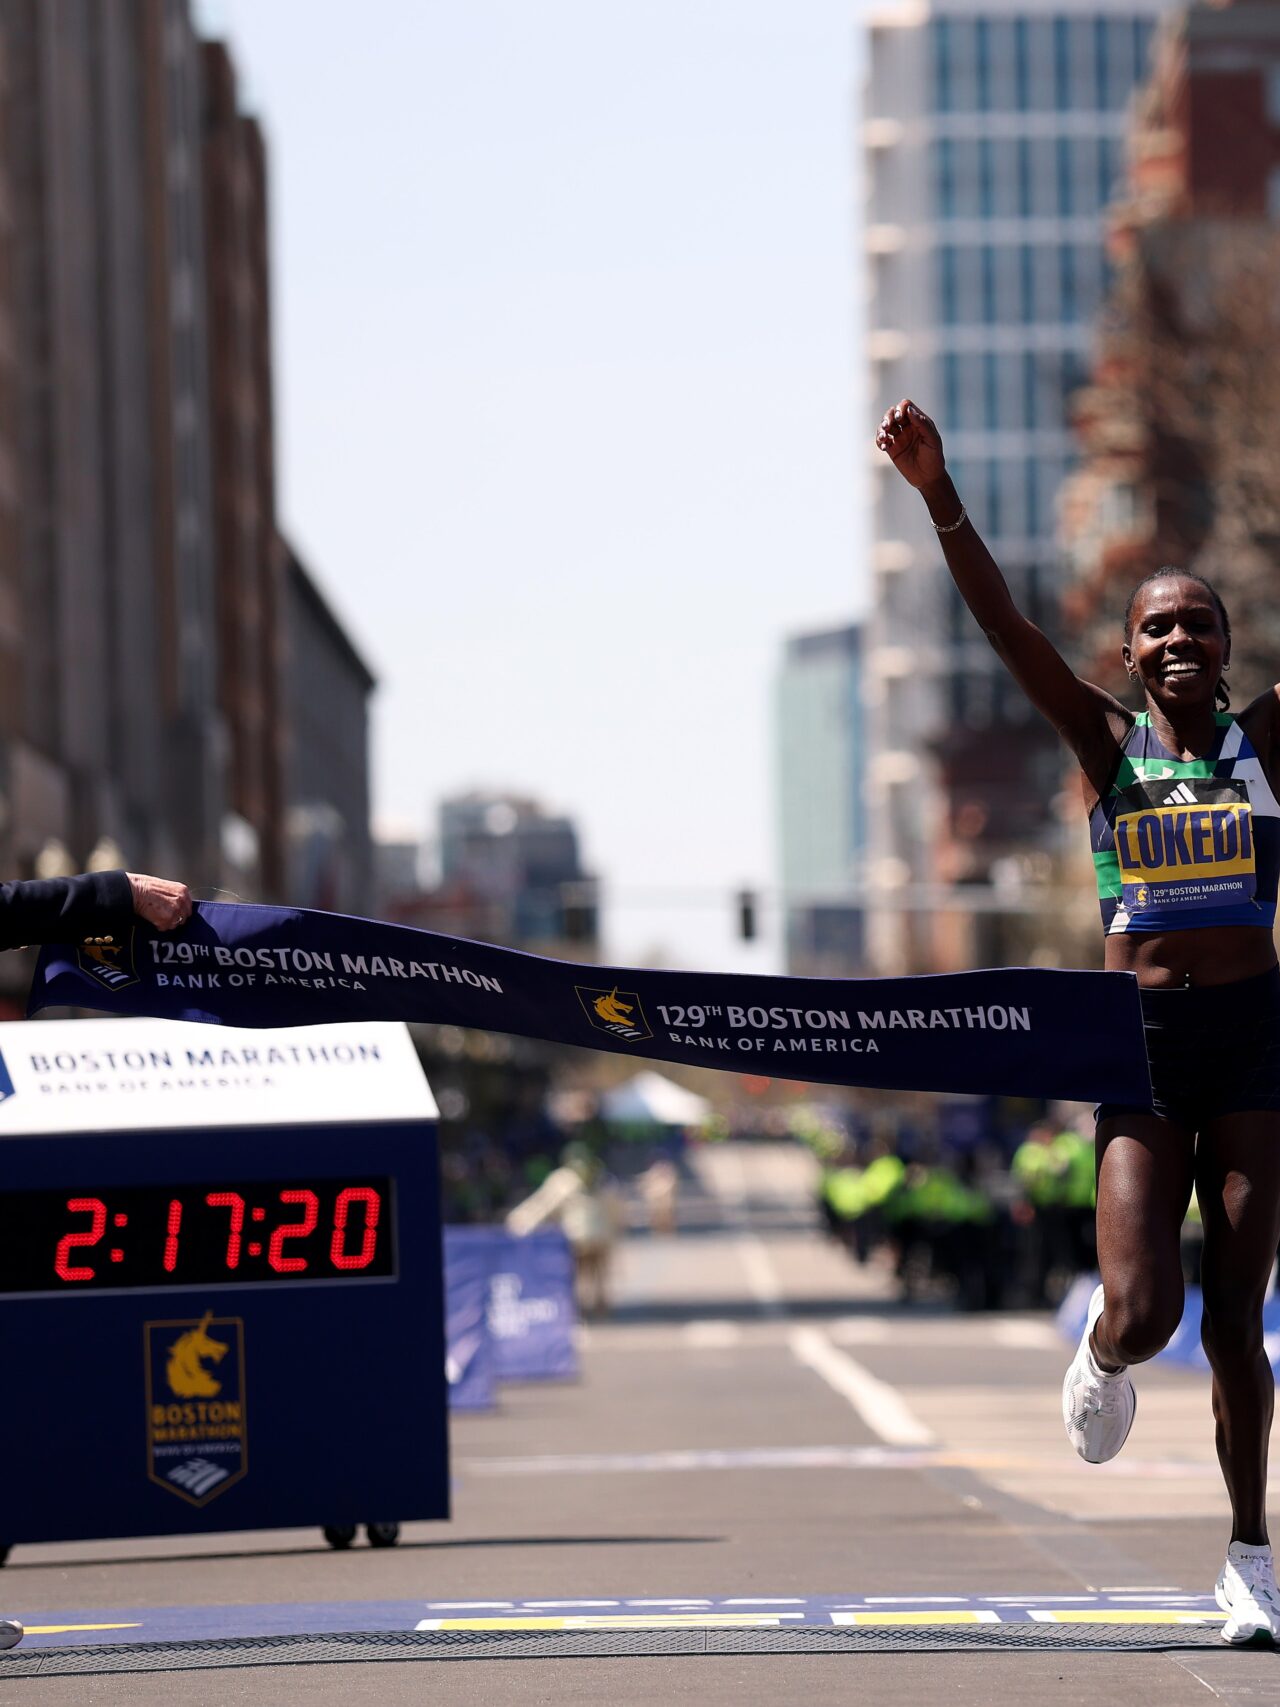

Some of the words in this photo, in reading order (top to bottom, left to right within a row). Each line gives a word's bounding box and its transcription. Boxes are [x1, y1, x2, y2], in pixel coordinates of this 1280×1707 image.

[1117, 808, 1251, 869] LOKEDI
[1169, 886, 1200, 896] BOSTON
[1202, 882, 1243, 893] MARATHON
[1180, 894, 1207, 902] AMERICA
[149, 940, 209, 964] 129TH
[214, 946, 335, 972] BOSTON
[341, 953, 503, 993] MARATHON
[156, 973, 221, 988] BANK
[228, 973, 256, 987] OF
[265, 973, 367, 991] AMERICA
[656, 1005, 722, 1028] 129TH
[727, 1006, 850, 1029] BOSTON
[857, 1005, 1031, 1030] MARATHON
[669, 1032, 731, 1050] BANK
[737, 1038, 765, 1051] OF
[773, 1038, 879, 1052] AMERICA
[30, 1049, 172, 1074] BOSTON
[186, 1043, 382, 1070] MARATHON
[54, 1187, 381, 1281] 2:17:20
[152, 1401, 241, 1425] BOSTON
